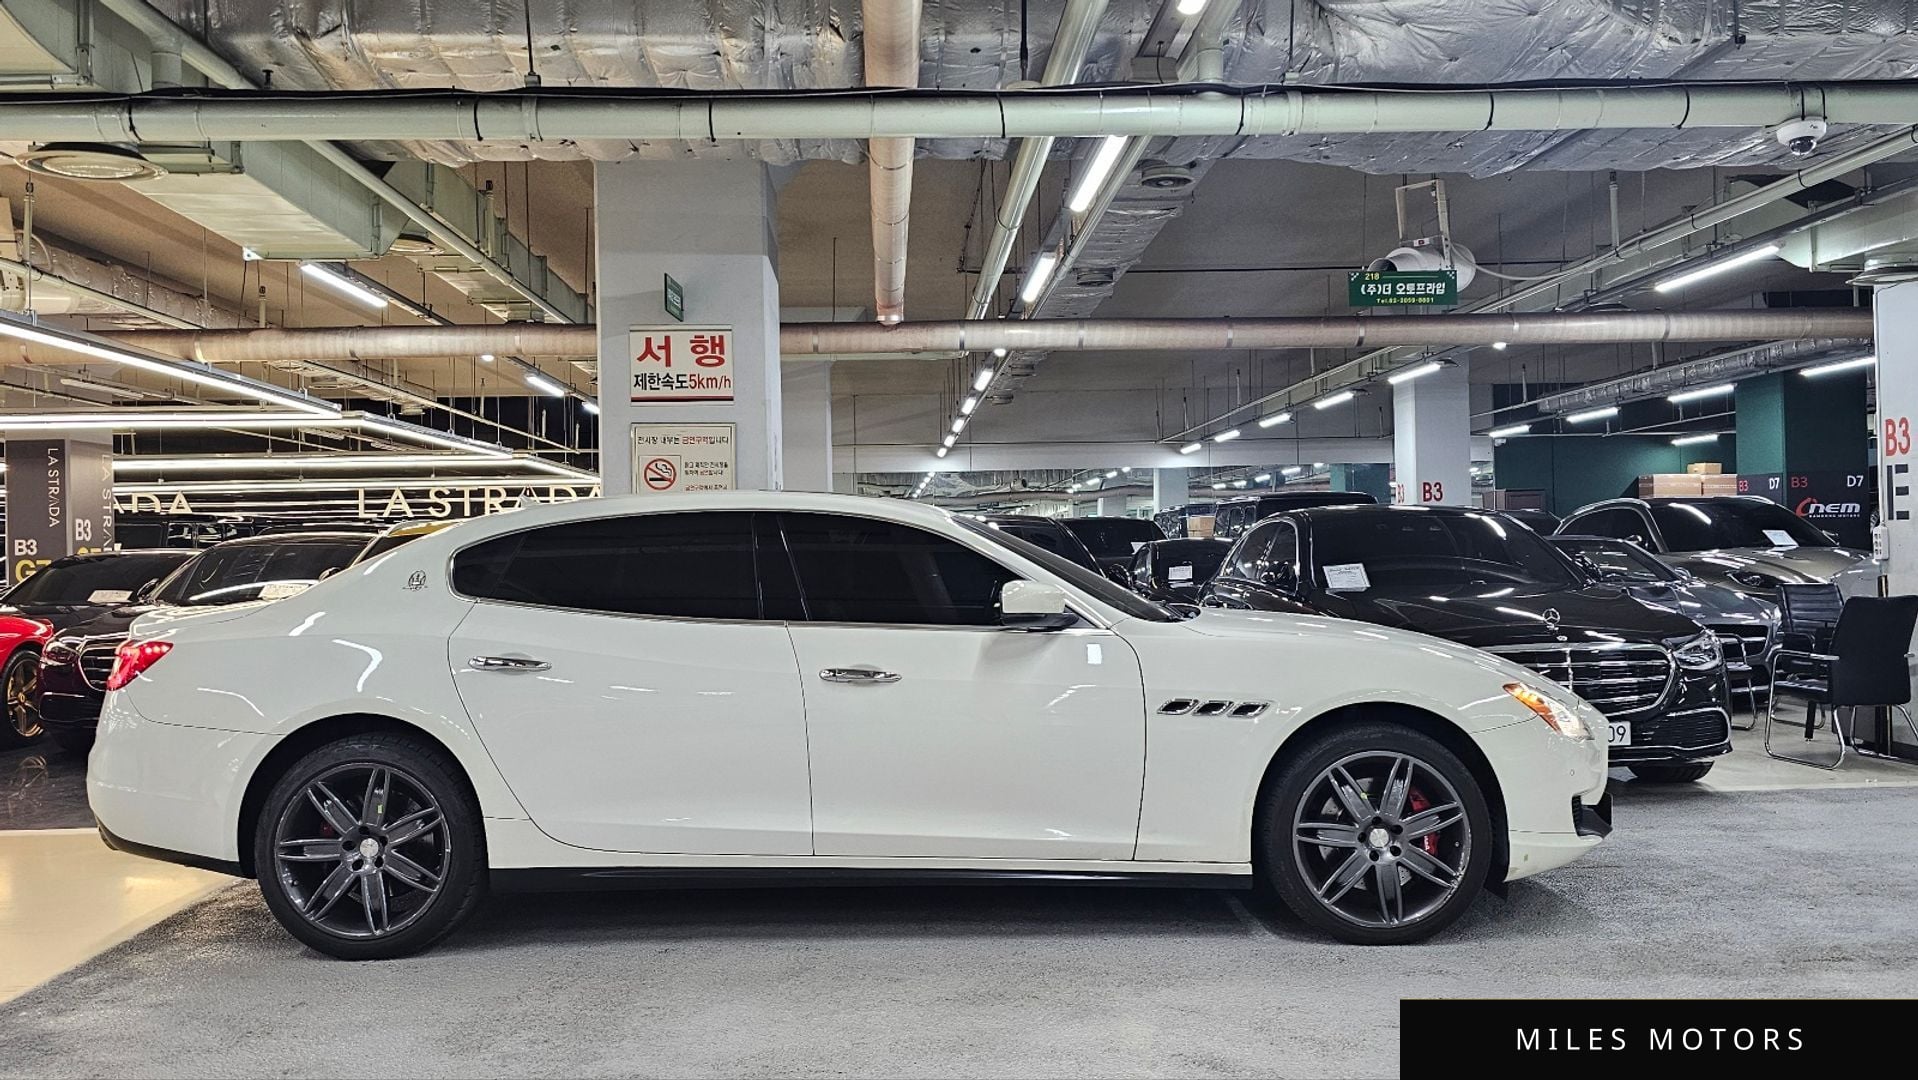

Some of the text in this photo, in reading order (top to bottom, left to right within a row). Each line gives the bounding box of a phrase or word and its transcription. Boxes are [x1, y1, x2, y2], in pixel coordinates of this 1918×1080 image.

[633, 373, 732, 391] 제한속도5km/h
[637, 436, 659, 445] 전시장
[682, 436, 729, 445] 금연구역입니다
[1885, 416, 1911, 457] B3
[47, 448, 61, 528] LA STRADA
[1738, 480, 1749, 491] B3
[1768, 477, 1780, 490] D7
[1791, 476, 1808, 488] B3
[1846, 475, 1864, 487] D7
[1422, 481, 1444, 502] B3
[101, 454, 114, 552] LA STRA
[357, 486, 414, 518] LA
[75, 518, 92, 542] B3
[14, 539, 38, 556] B3
